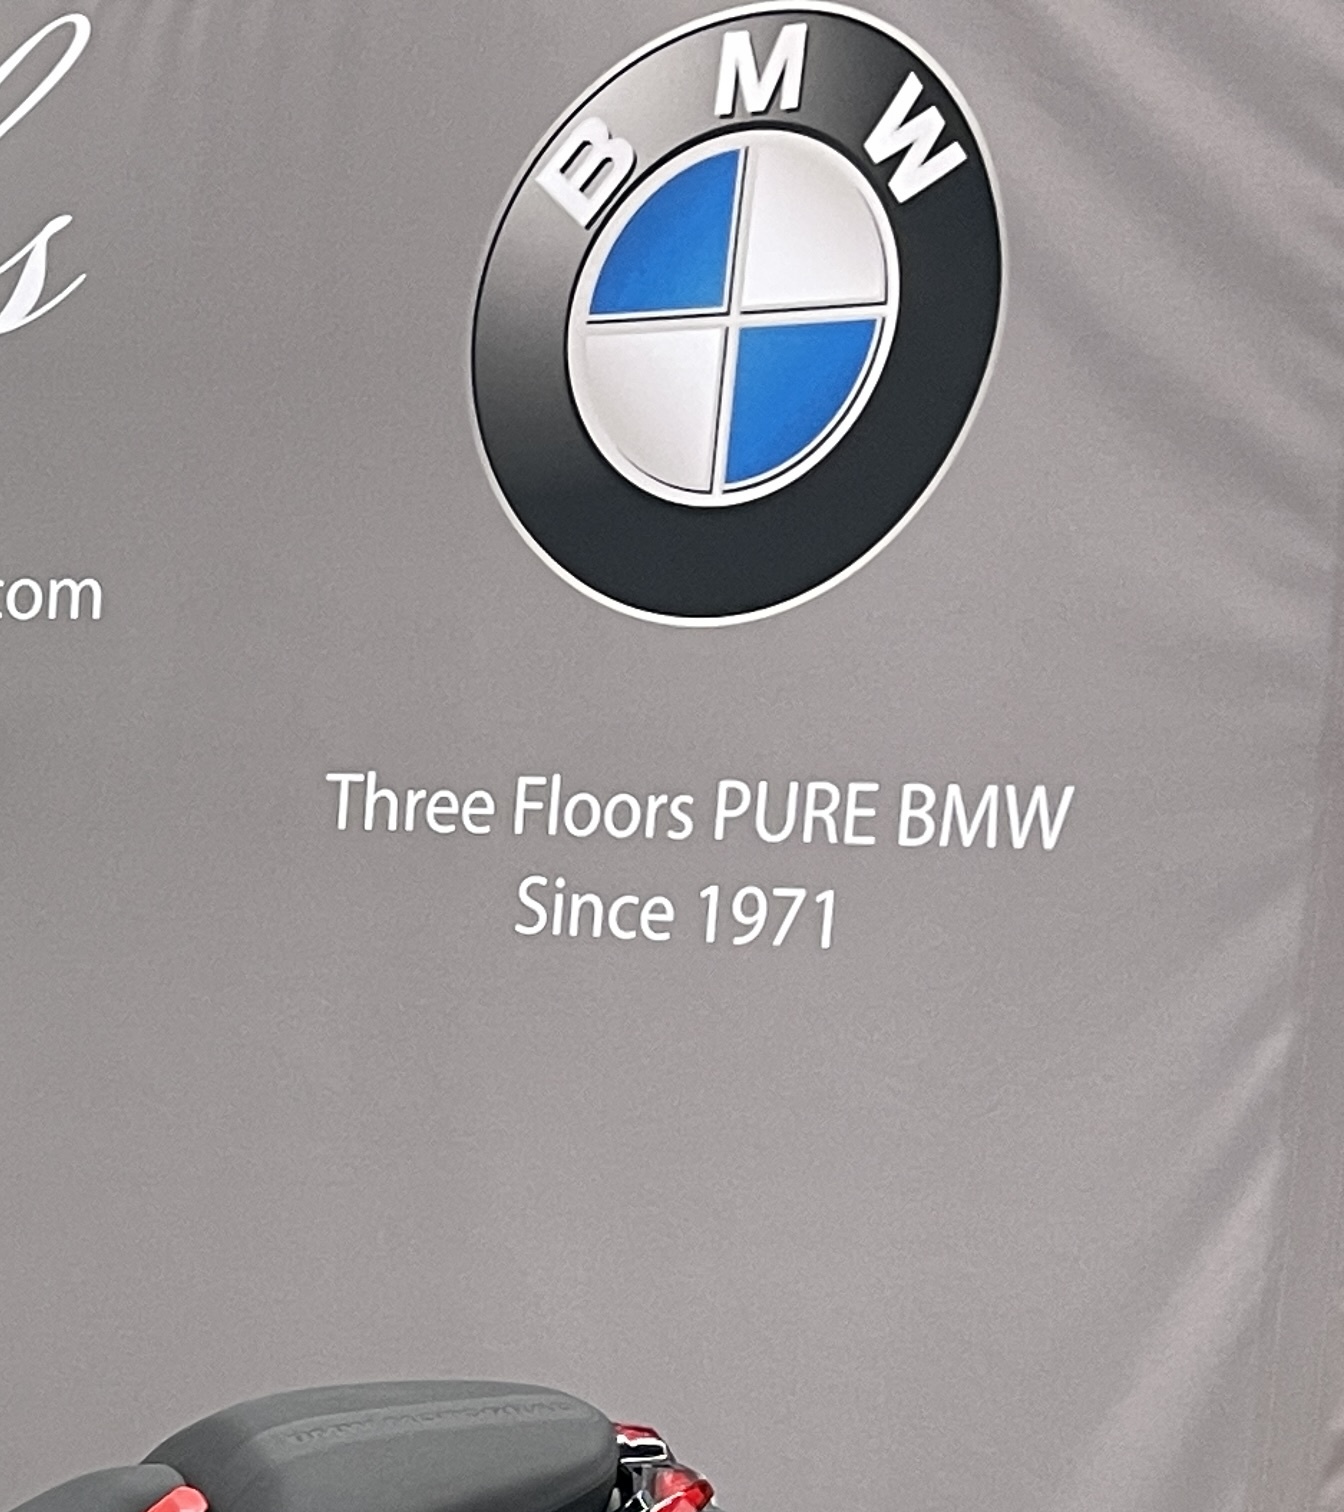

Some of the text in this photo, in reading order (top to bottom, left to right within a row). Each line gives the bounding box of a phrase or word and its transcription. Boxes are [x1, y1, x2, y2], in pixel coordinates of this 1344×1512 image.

[535, 22, 969, 230] BMW
[324, 769, 1076, 851] Three Floors PURE BMW
[513, 874, 836, 950] Since 1971
